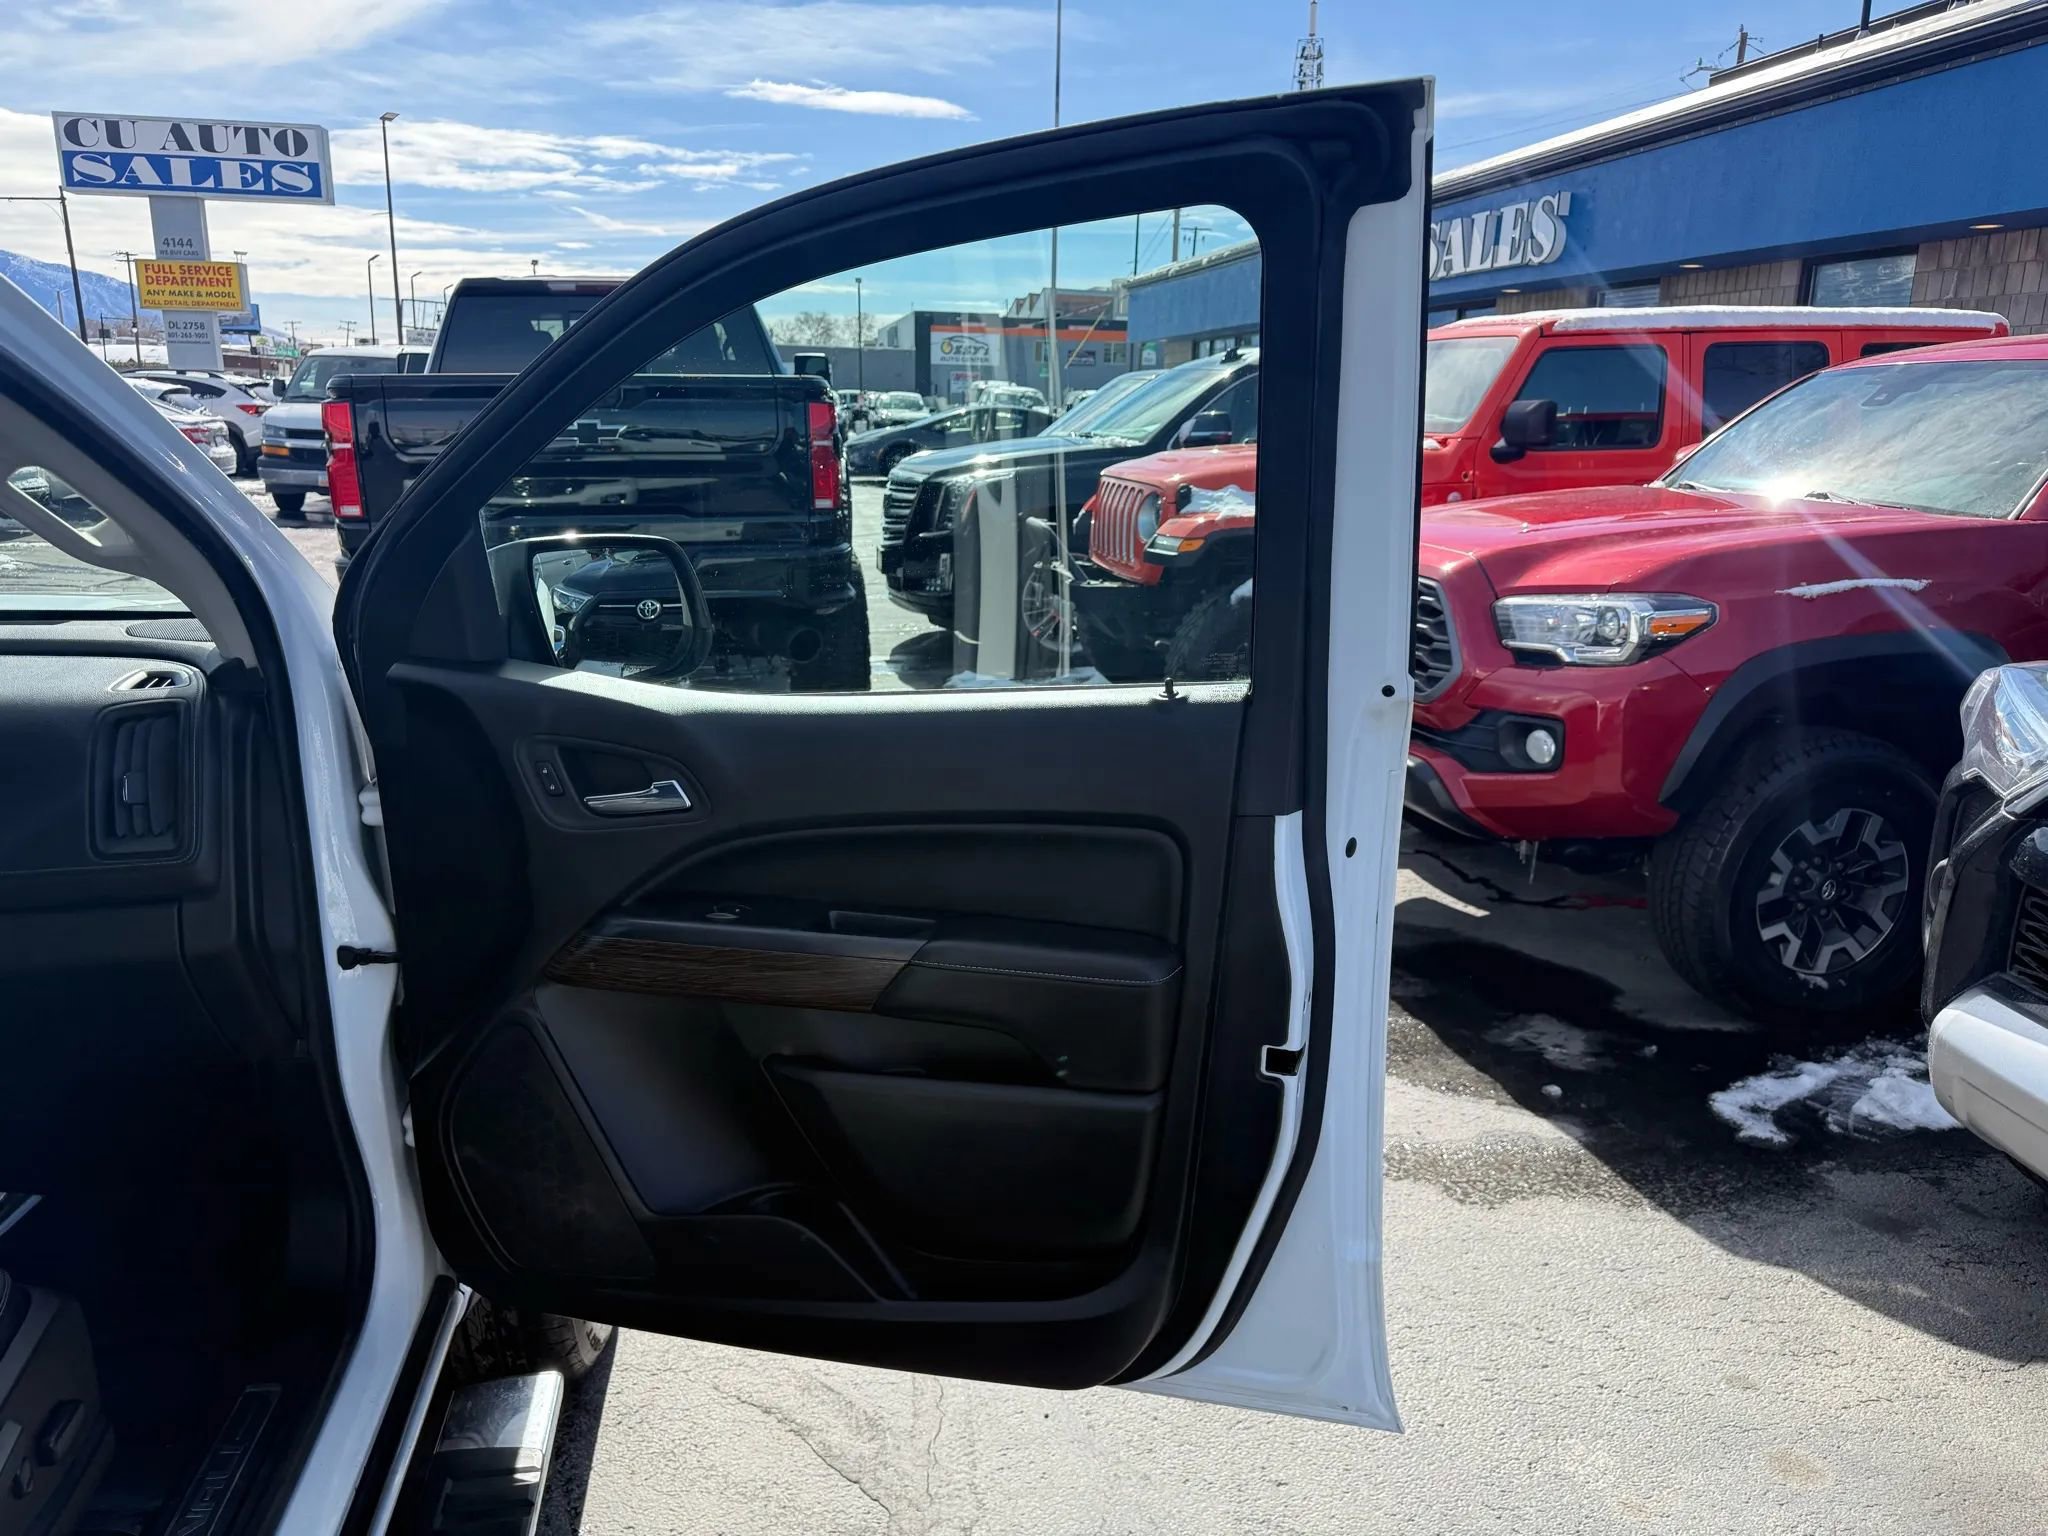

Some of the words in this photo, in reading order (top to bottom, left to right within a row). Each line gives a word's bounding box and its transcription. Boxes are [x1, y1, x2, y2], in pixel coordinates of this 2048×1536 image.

[63, 117, 138, 149] CU
[159, 122, 309, 157] AUTO
[72, 153, 313, 193] SALES
[162, 237, 193, 248] 4144
[144, 263, 176, 275] FULL
[179, 264, 232, 277] SERVICE
[145, 275, 233, 288] DEPARTMENT
[146, 288, 166, 297] ANY
[168, 289, 194, 298] MAKE
[196, 290, 203, 298] &
[205, 290, 236, 299] MODEL
[191, 300, 240, 308] DEPARTMENT
[168, 320, 181, 330] DL
[182, 321, 206, 330] 2758
